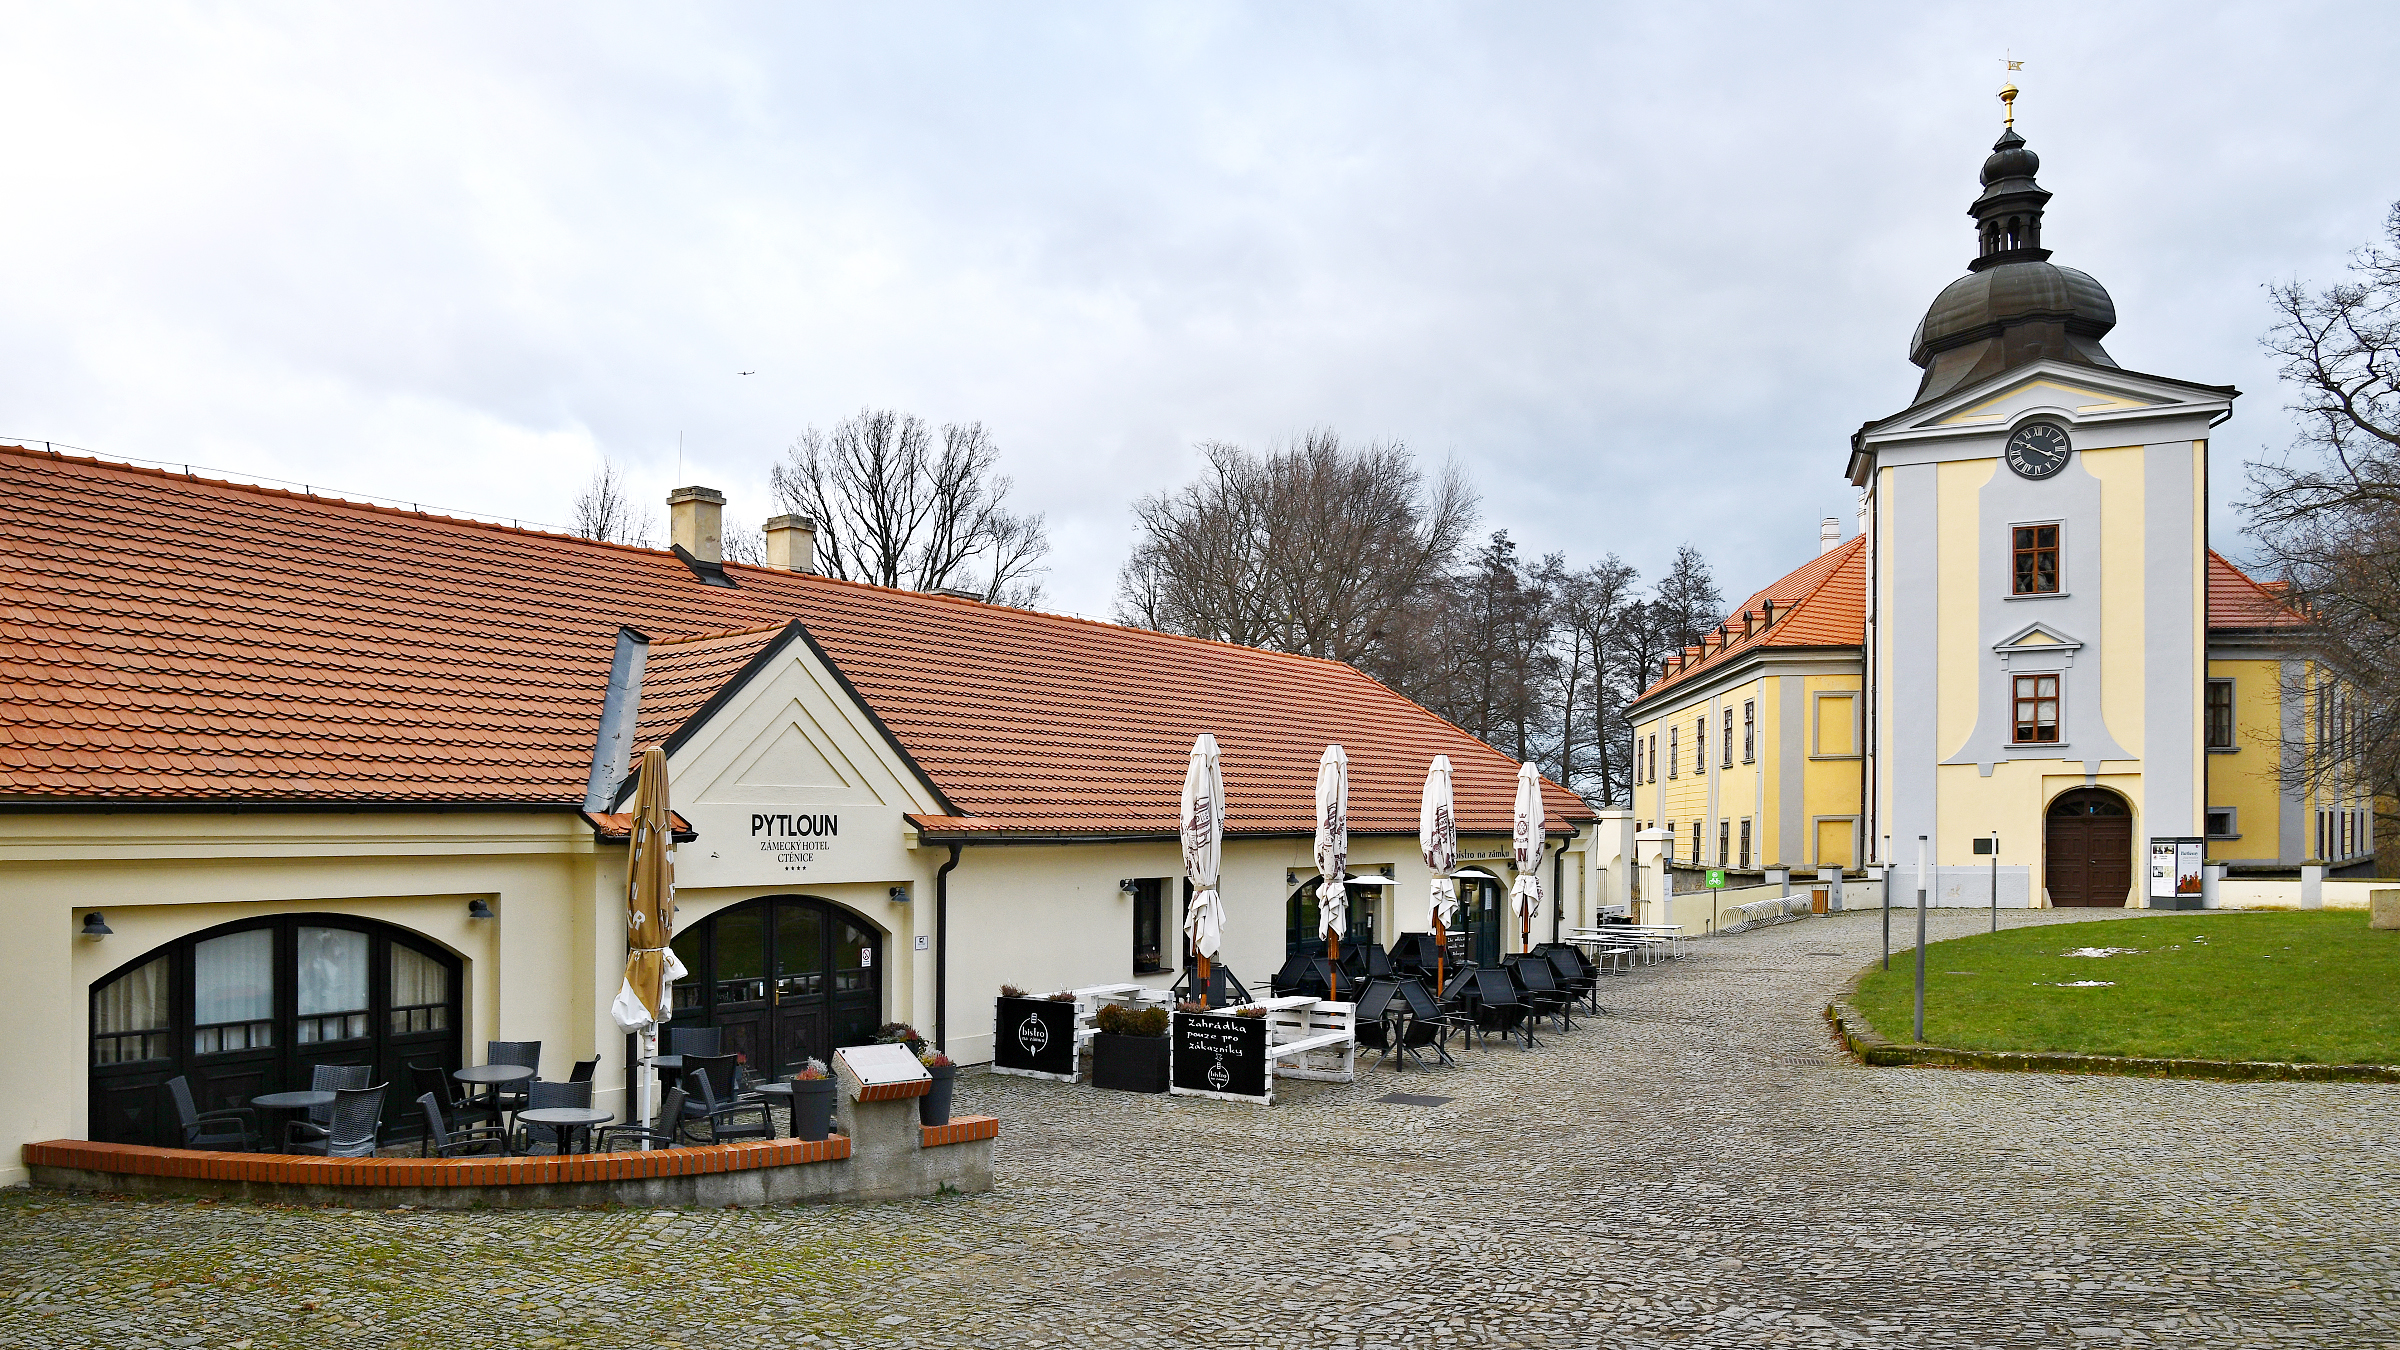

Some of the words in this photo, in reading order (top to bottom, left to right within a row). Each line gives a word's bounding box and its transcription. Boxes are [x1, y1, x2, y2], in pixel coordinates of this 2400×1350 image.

[752, 814, 837, 836] PYTLOUN
[760, 840, 801, 850] ZÁMECKÝ
[802, 841, 829, 851] HOTEL
[1488, 844, 1510, 858] zámku
[1022, 1026, 1045, 1037] bistro
[1188, 1018, 1247, 1033] Zahrádka
[1187, 1031, 1217, 1039] pouze
[1221, 1035, 1239, 1043] pro
